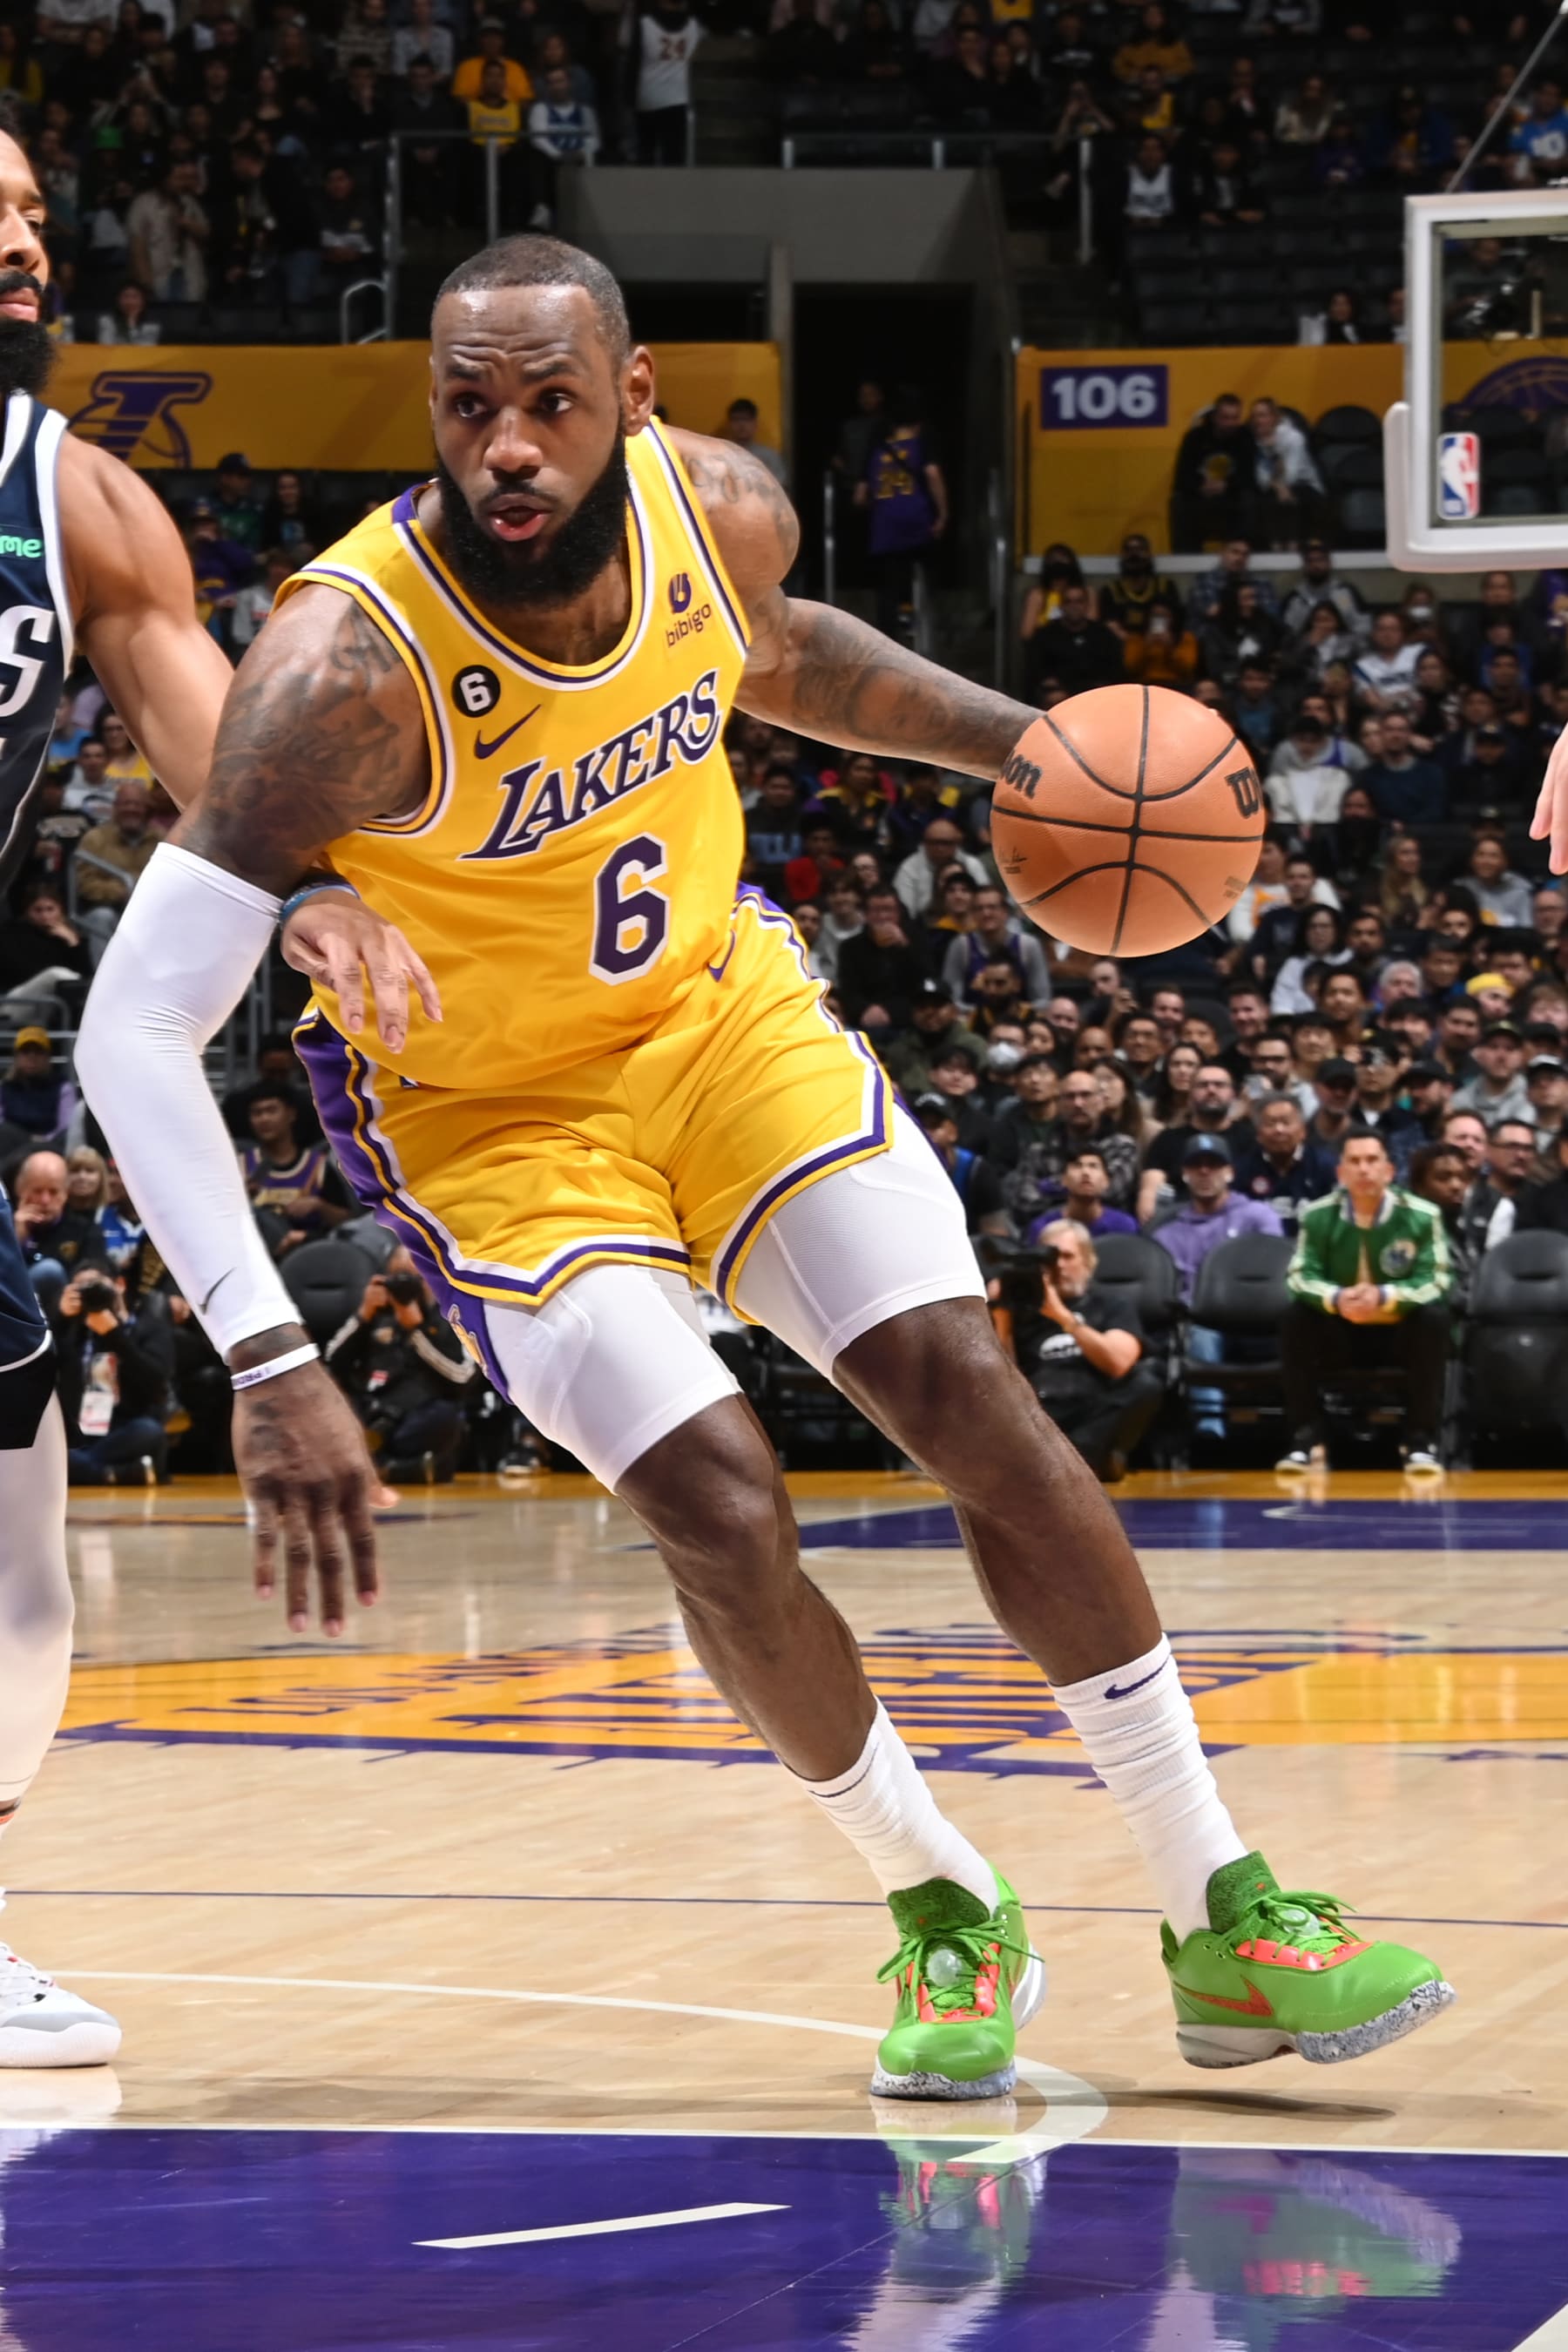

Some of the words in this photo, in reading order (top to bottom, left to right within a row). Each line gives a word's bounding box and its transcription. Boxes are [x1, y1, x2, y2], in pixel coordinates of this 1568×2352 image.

[1051, 374, 1157, 421] 106
[665, 603, 712, 648] bibigo
[459, 672, 491, 712] 6
[456, 669, 720, 861] LAKERS
[589, 831, 670, 986] 6
